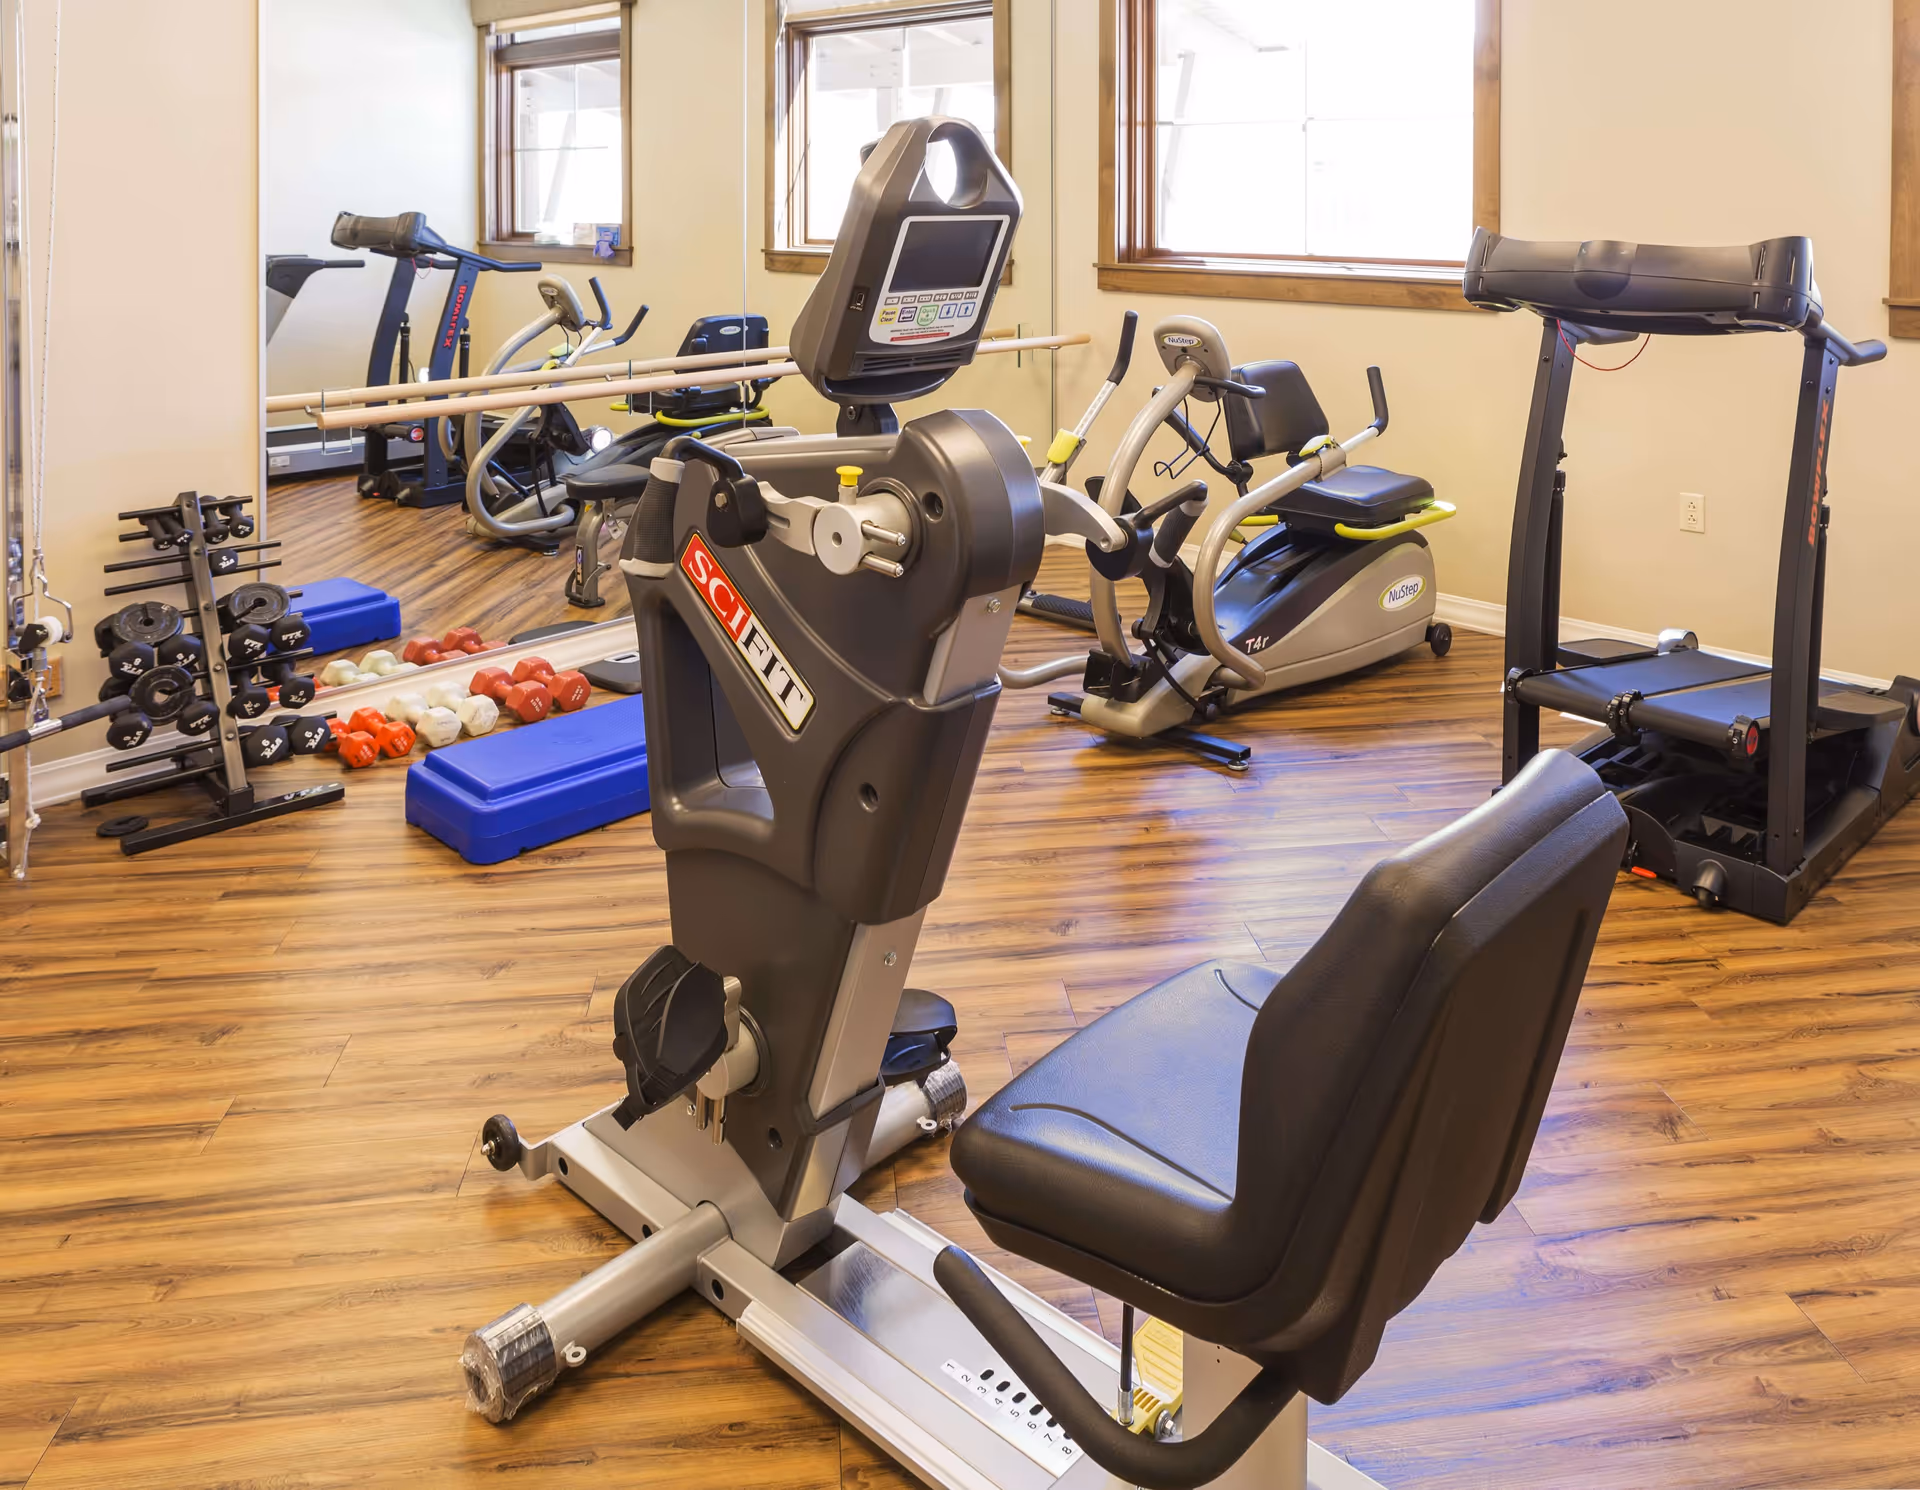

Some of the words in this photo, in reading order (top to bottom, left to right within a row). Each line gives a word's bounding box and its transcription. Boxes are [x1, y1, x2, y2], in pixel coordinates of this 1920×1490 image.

[1168, 337, 1194, 345] NuStep
[1808, 399, 1829, 545] BOWFLEX
[1388, 582, 1419, 603] NuStep
[688, 550, 804, 708] SCIFIT
[1245, 635, 1269, 654] T4r
[961, 1374, 971, 1382] 2
[977, 1386, 987, 1394] 3
[994, 1397, 1003, 1405] 4
[1010, 1409, 1020, 1418] 5
[1027, 1421, 1037, 1430] 6
[1043, 1433, 1053, 1442] 7
[1062, 1446, 1072, 1455] 8
